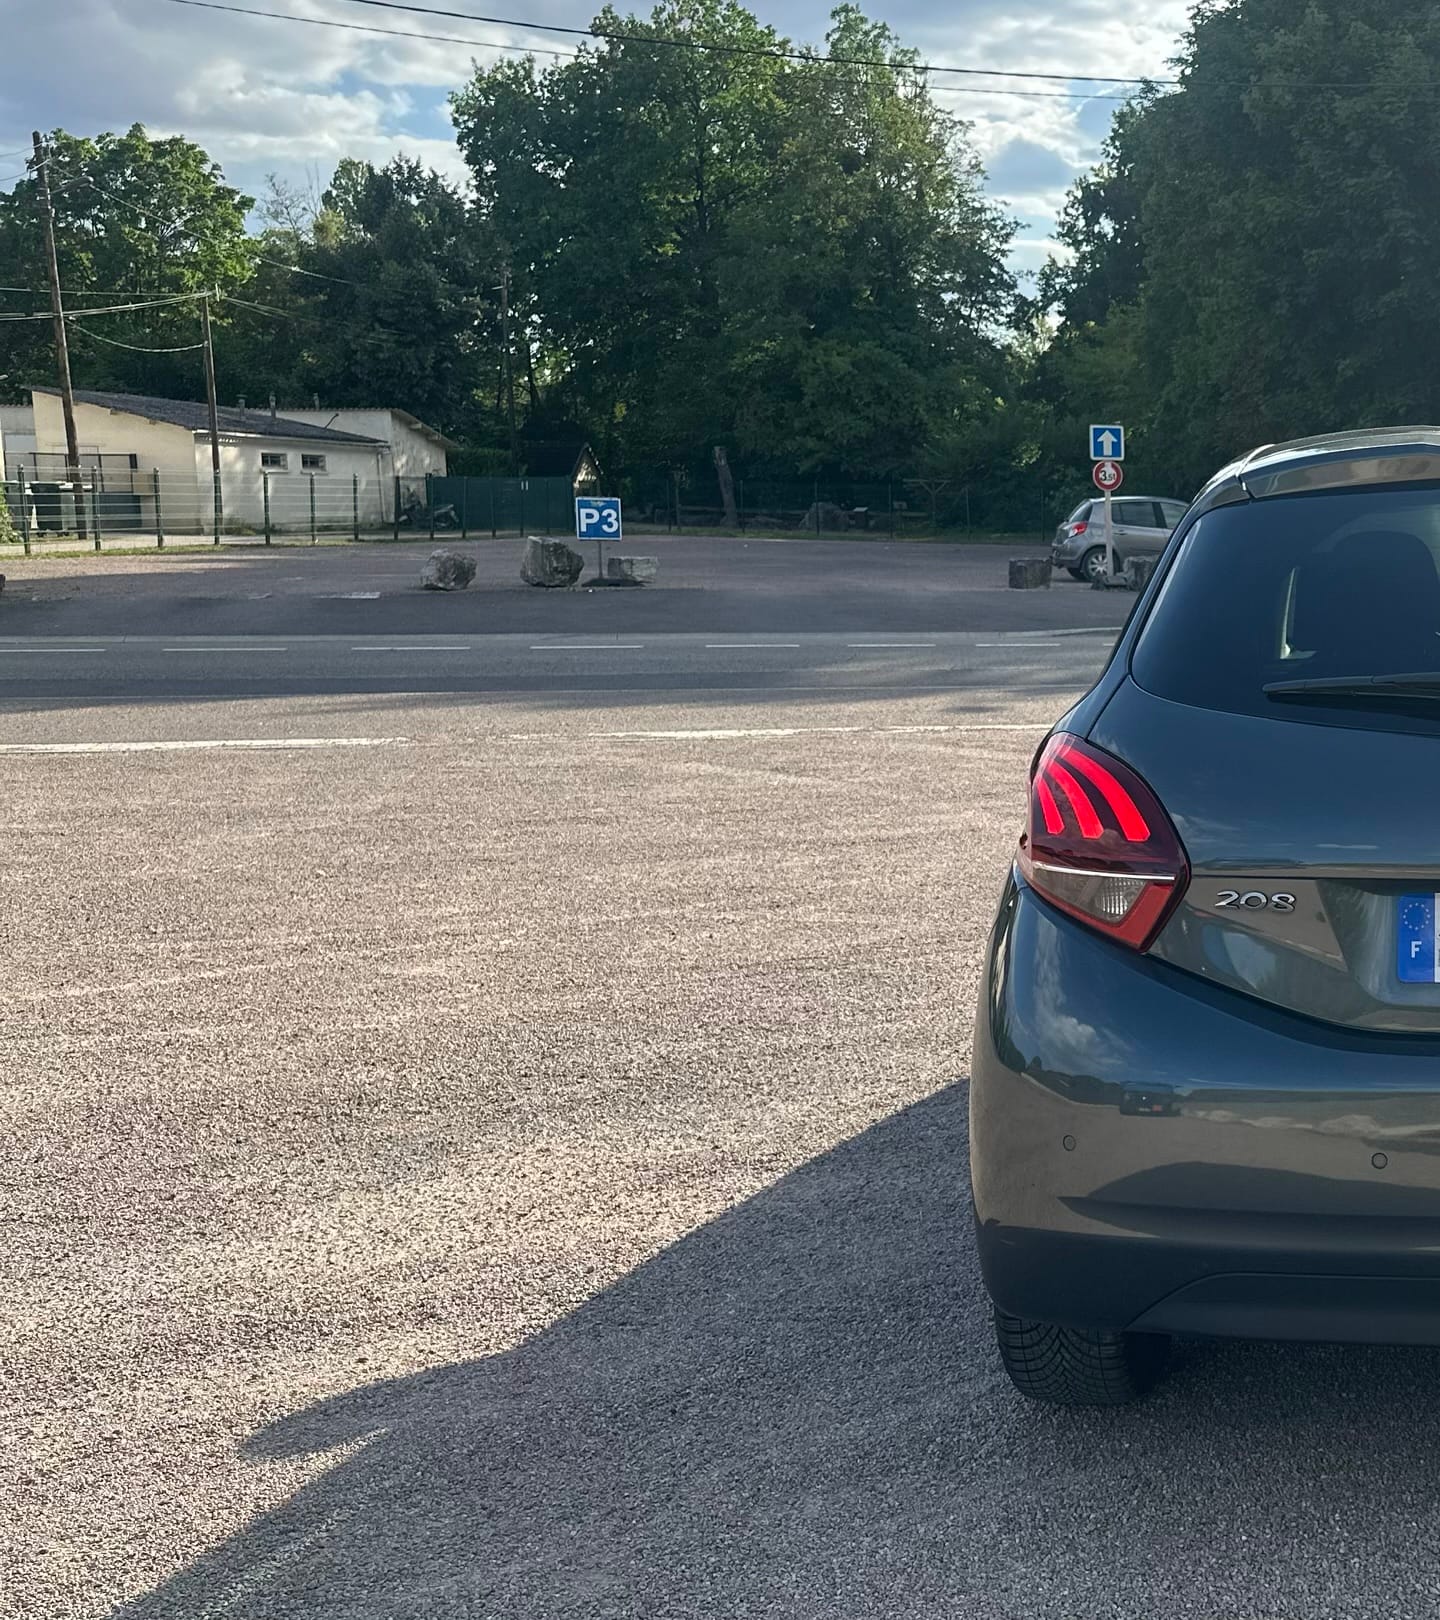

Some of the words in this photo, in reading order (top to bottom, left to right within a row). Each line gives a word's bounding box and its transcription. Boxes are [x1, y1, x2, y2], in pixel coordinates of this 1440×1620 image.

[580, 508, 619, 533] P3
[1215, 890, 1296, 913] 208
[1411, 941, 1422, 958] F
